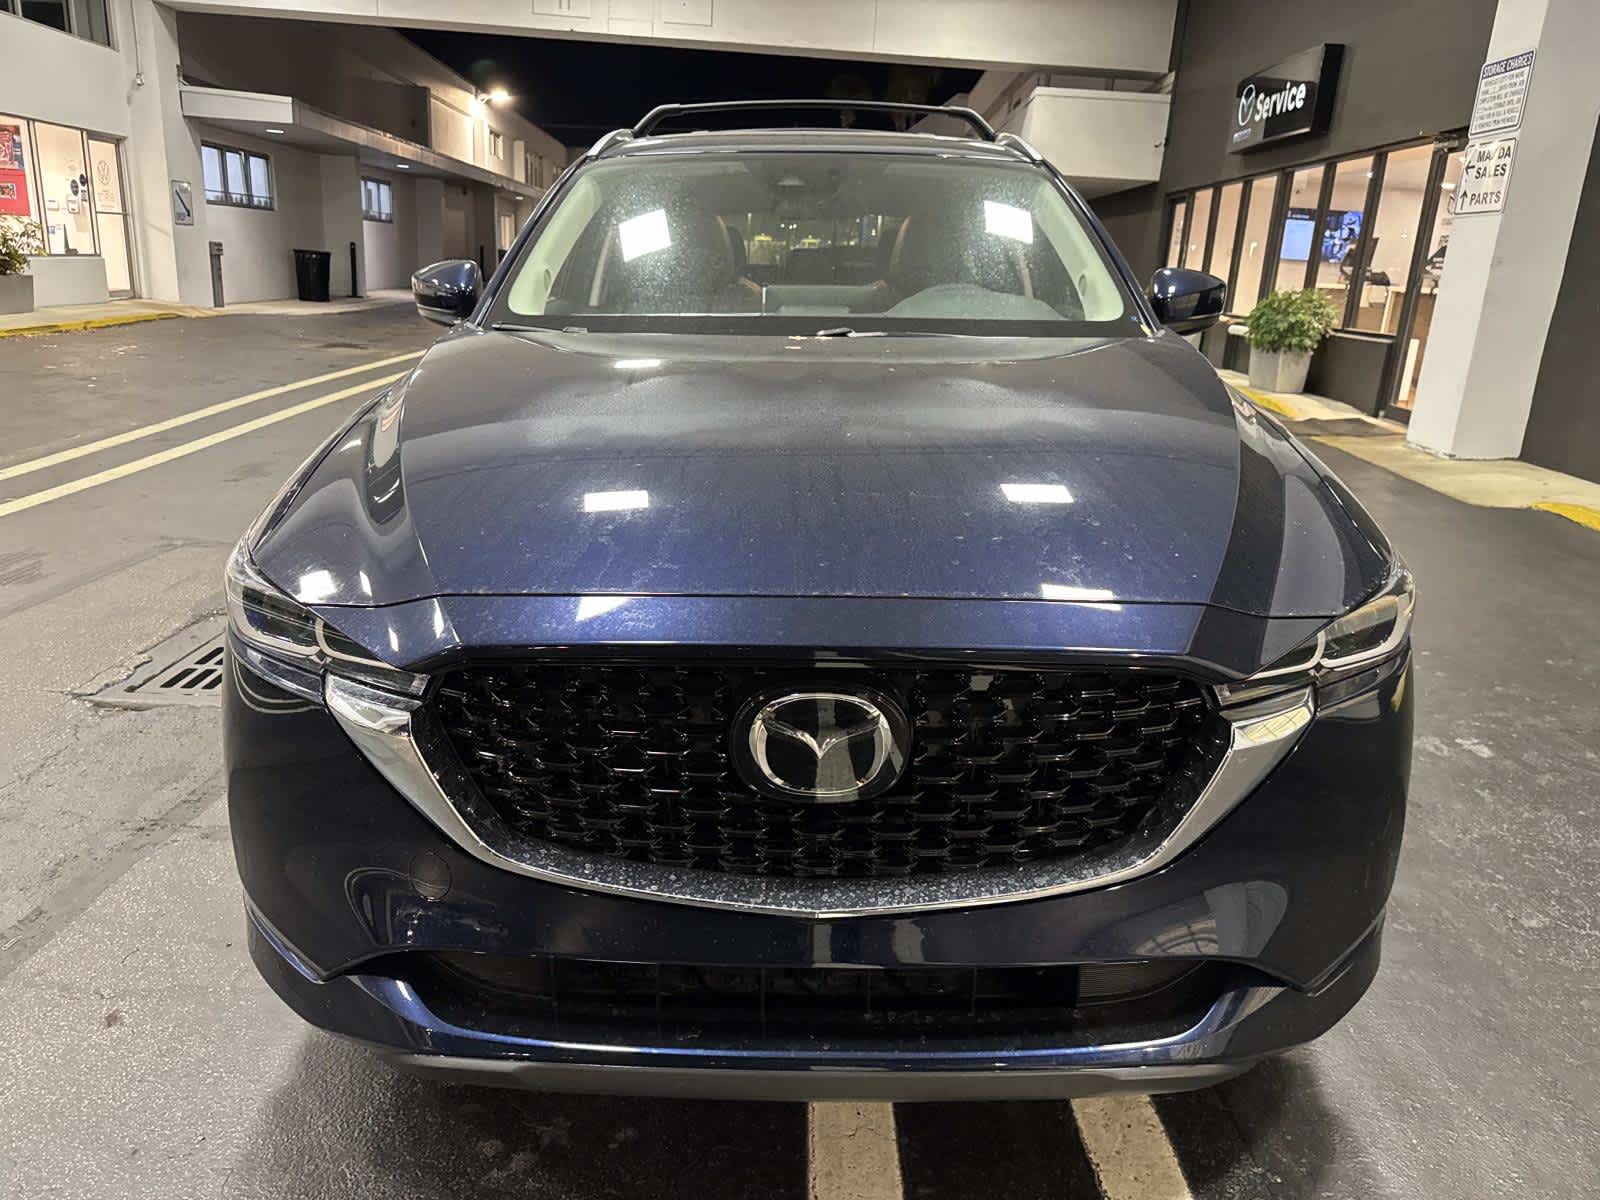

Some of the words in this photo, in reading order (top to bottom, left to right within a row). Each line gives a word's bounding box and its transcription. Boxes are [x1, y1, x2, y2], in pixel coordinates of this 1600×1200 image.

[1254, 81, 1306, 122] Service
[1477, 146, 1511, 163] MADA
[1475, 163, 1507, 179] SAES
[1469, 191, 1501, 206] PARTS
